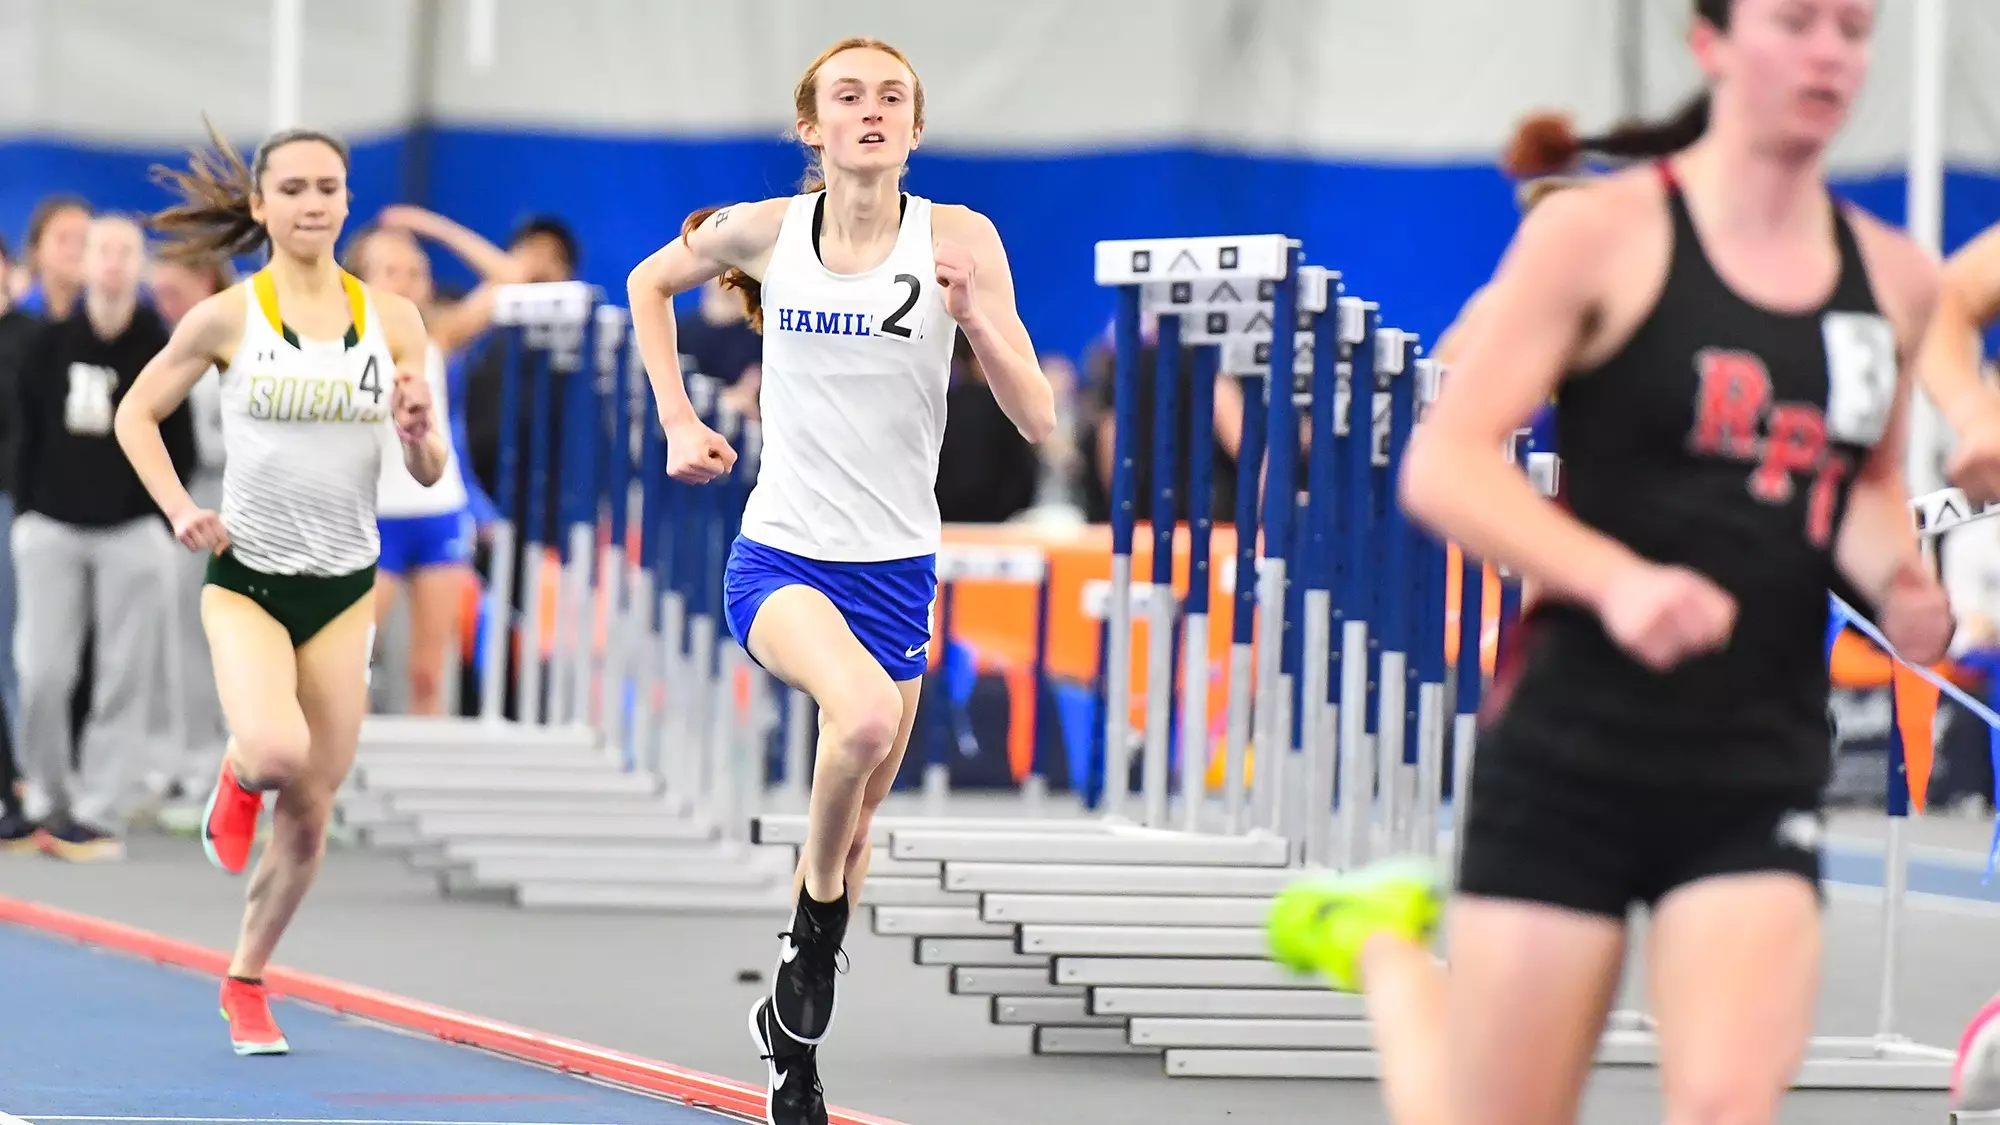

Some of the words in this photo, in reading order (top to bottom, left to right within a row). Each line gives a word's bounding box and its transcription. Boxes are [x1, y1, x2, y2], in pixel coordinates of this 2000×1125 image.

[778, 308, 923, 341] HAMIL
[880, 273, 921, 339] 2
[250, 373, 386, 424] SIEN
[359, 354, 382, 404] 4
[1688, 347, 1848, 547] RPI
